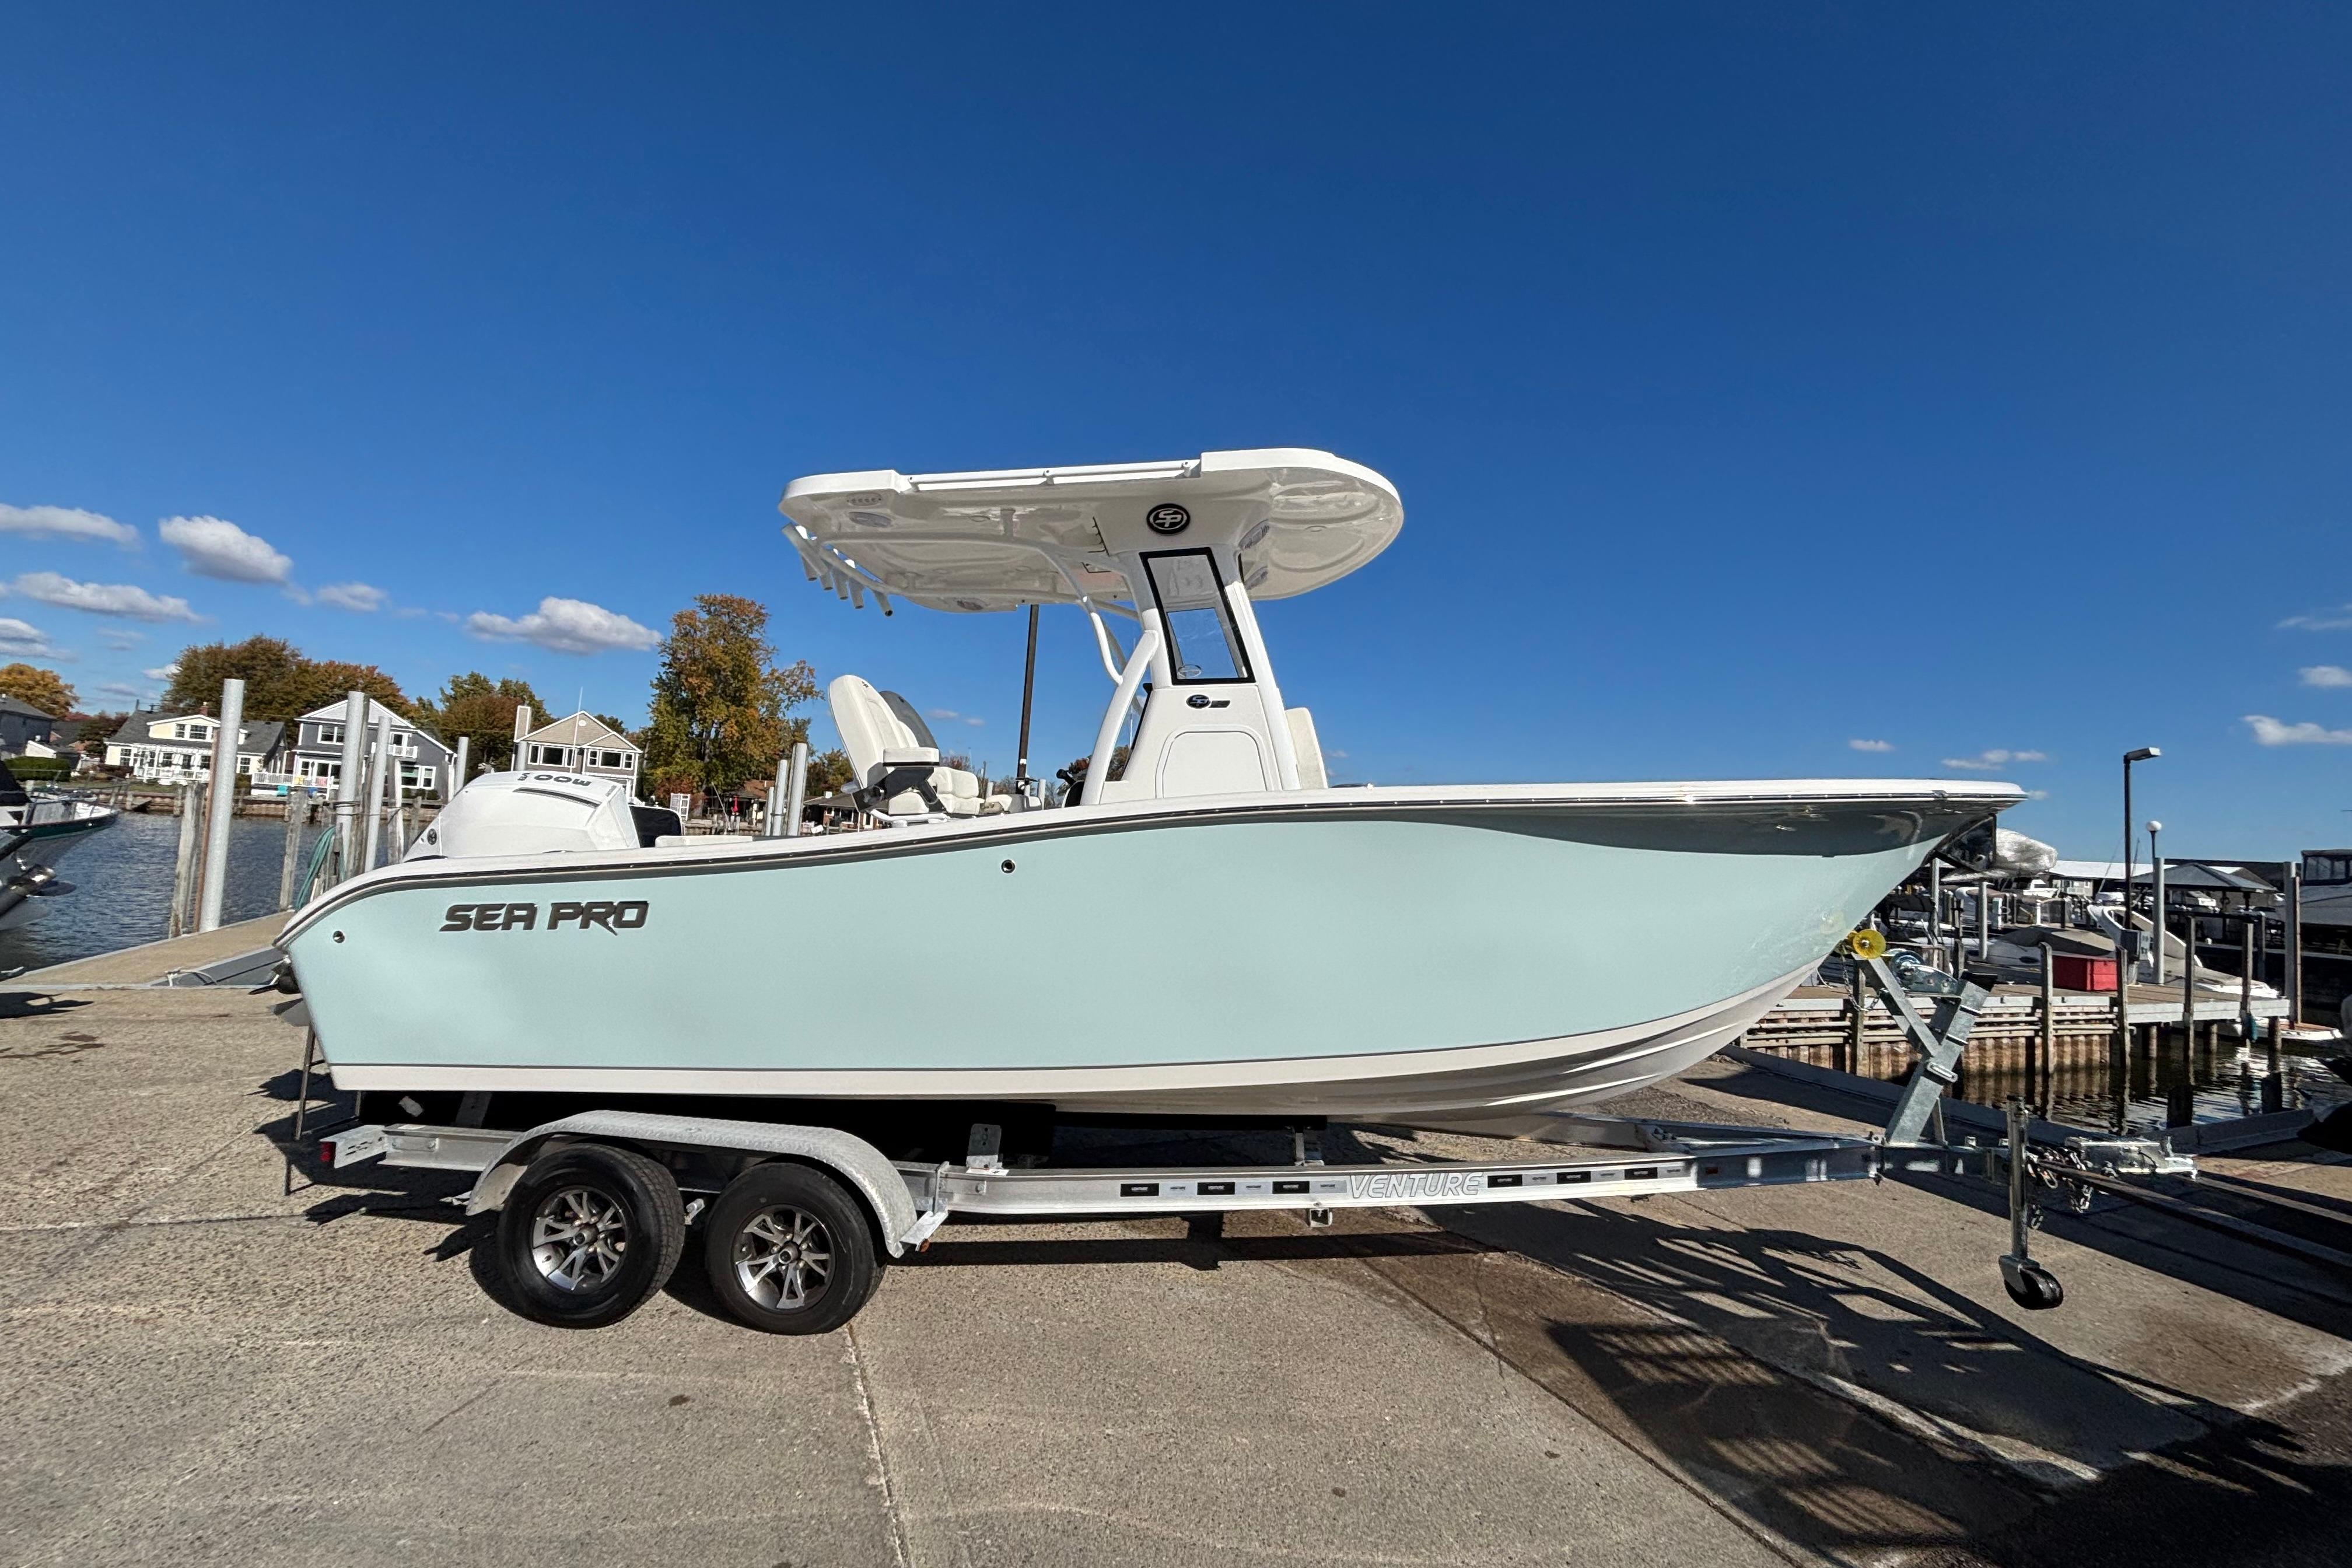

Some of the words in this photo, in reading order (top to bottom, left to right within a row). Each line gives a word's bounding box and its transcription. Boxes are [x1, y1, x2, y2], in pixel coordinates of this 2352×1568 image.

[439, 903, 537, 932] SEA
[547, 901, 649, 936] PRO
[1350, 1172, 1483, 1198] VENTURE
